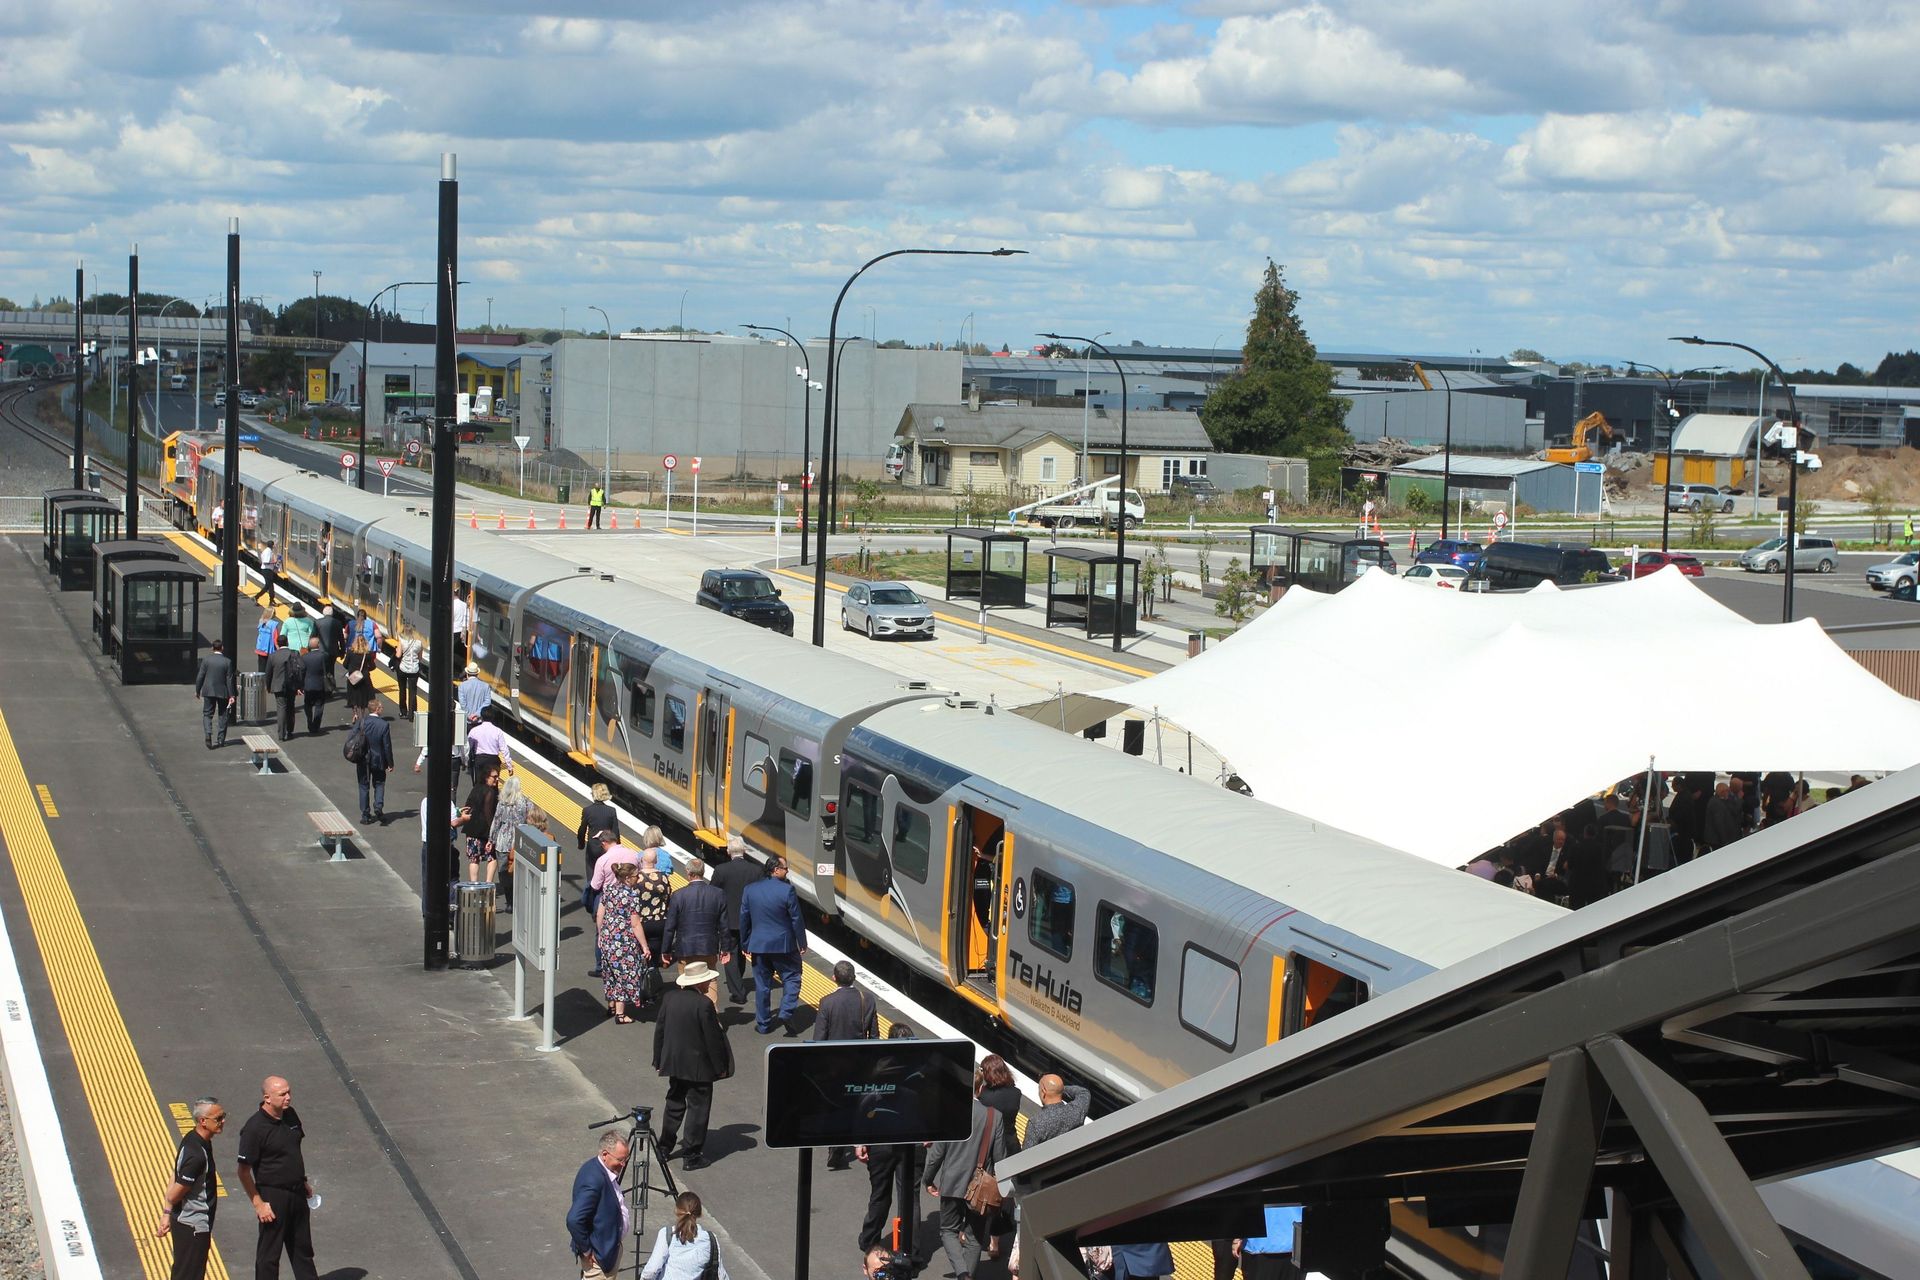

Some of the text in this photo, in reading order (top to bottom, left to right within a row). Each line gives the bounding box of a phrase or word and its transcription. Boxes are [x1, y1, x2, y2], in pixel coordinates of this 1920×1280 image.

[653, 752, 689, 790] Te Huia
[1009, 949, 1082, 1016] Te Huia
[1030, 994, 1050, 1015] Waikato
[1056, 1009, 1081, 1031] Auckland
[845, 1083, 896, 1092] Te Huia
[61, 1219, 85, 1257] MIND THE GAP
